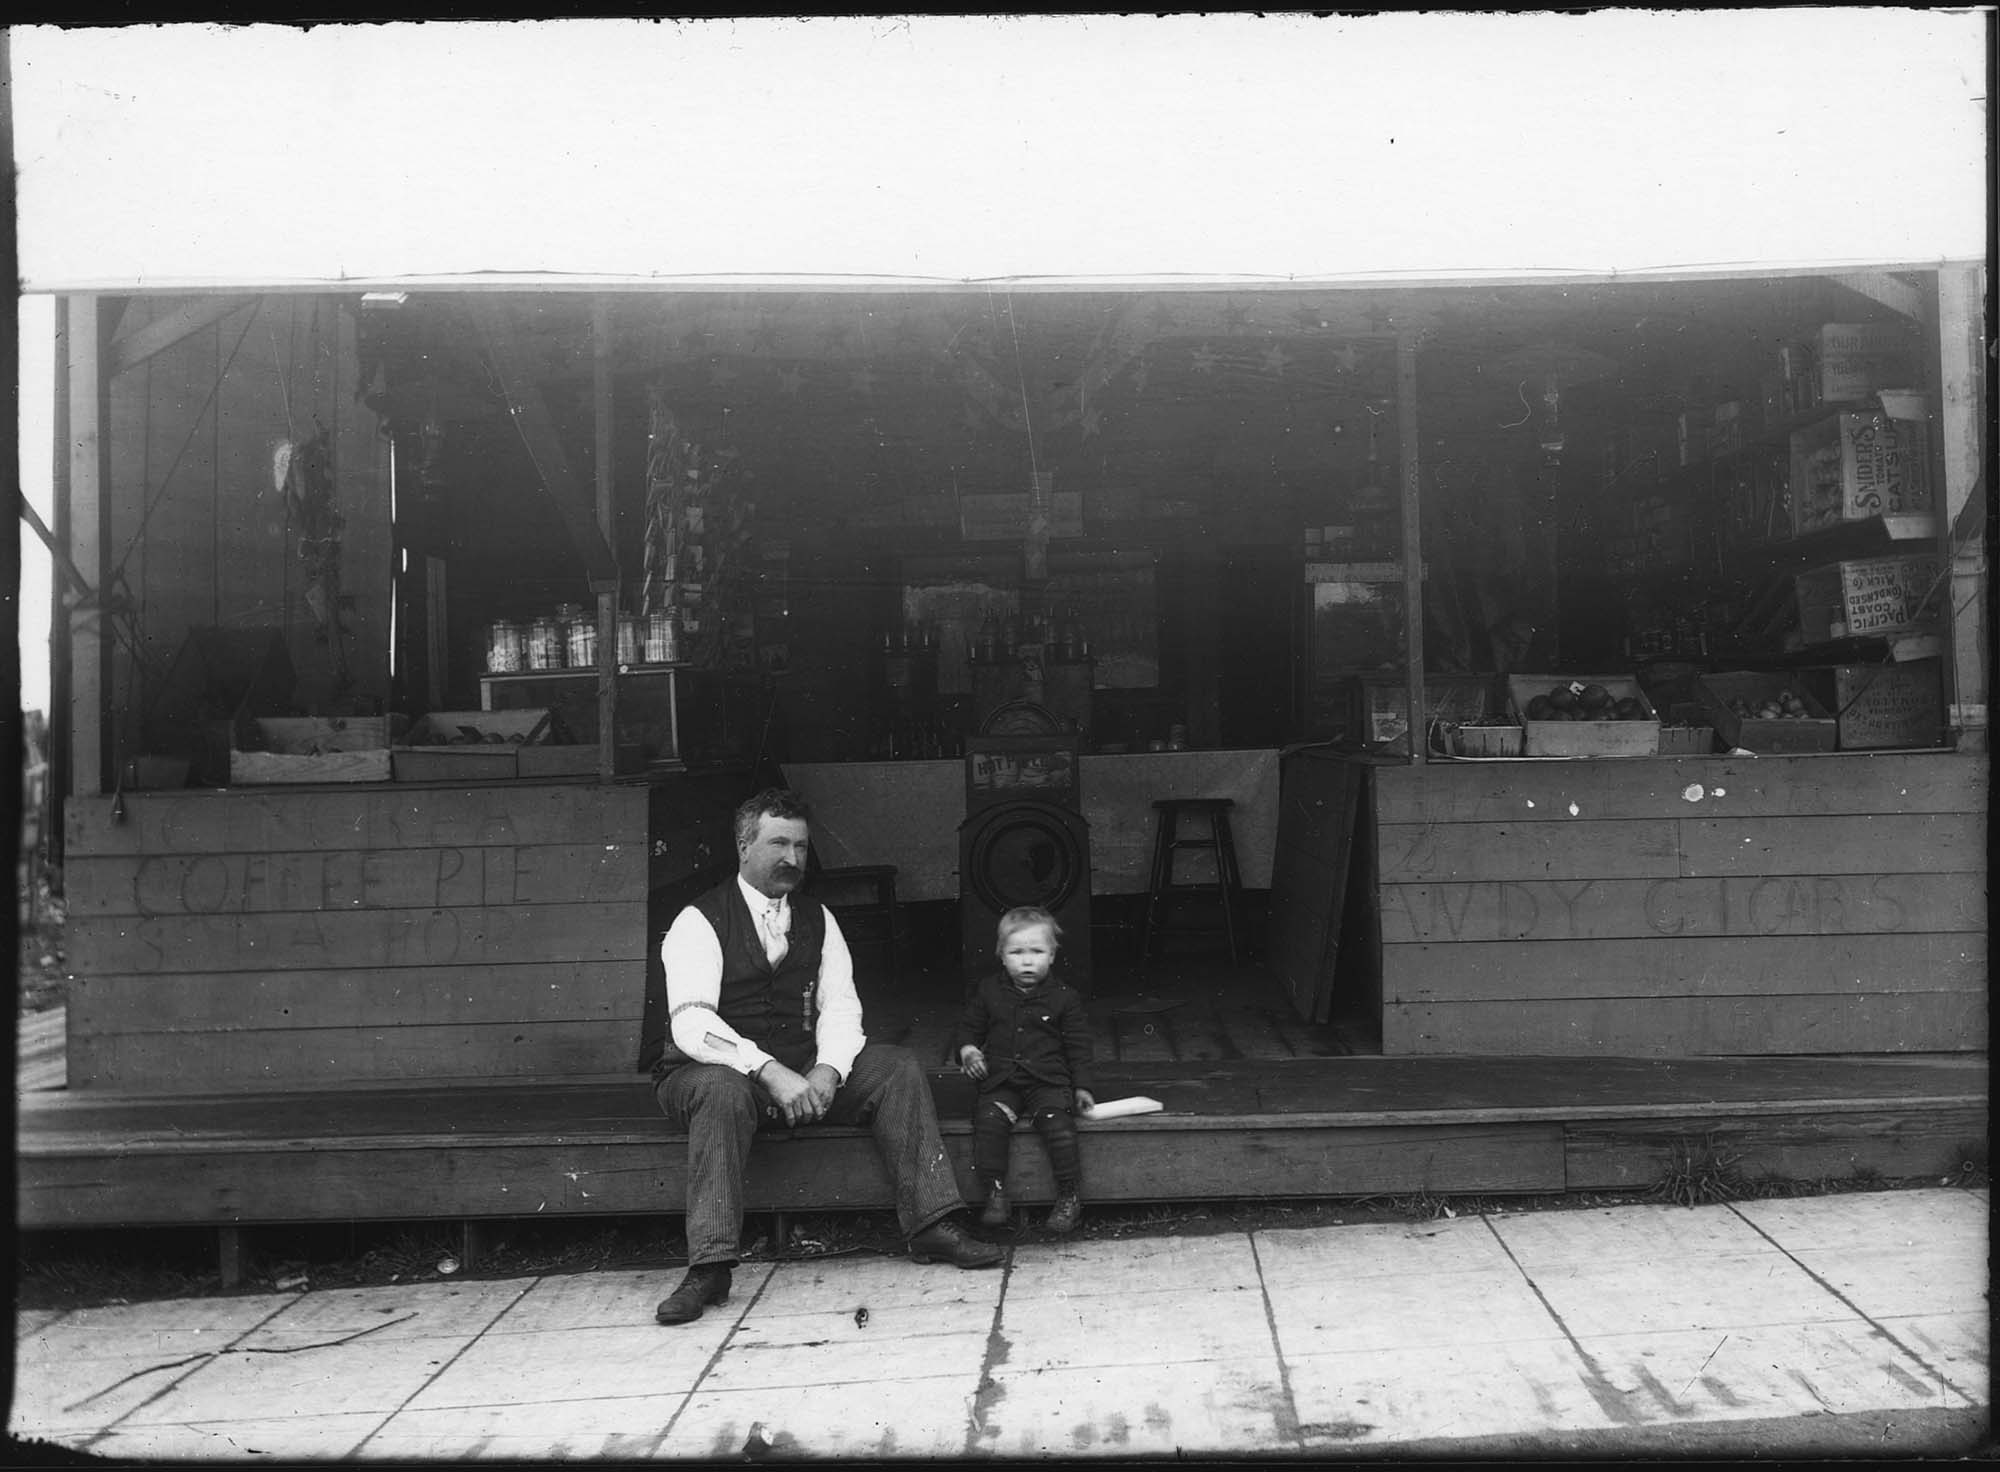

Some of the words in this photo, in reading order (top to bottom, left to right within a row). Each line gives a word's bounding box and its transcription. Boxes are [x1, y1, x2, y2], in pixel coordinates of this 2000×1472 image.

[1852, 425, 1881, 509] SNIDER'S
[1875, 445, 1885, 486] TOMATO
[1867, 575, 1896, 588] MILK
[1849, 585, 1902, 605] CONDENSED
[1851, 603, 1891, 616] COAST
[1853, 606, 1905, 630] PACIFIC
[132, 848, 388, 919] COFFEE
[433, 846, 533, 908] PIE
